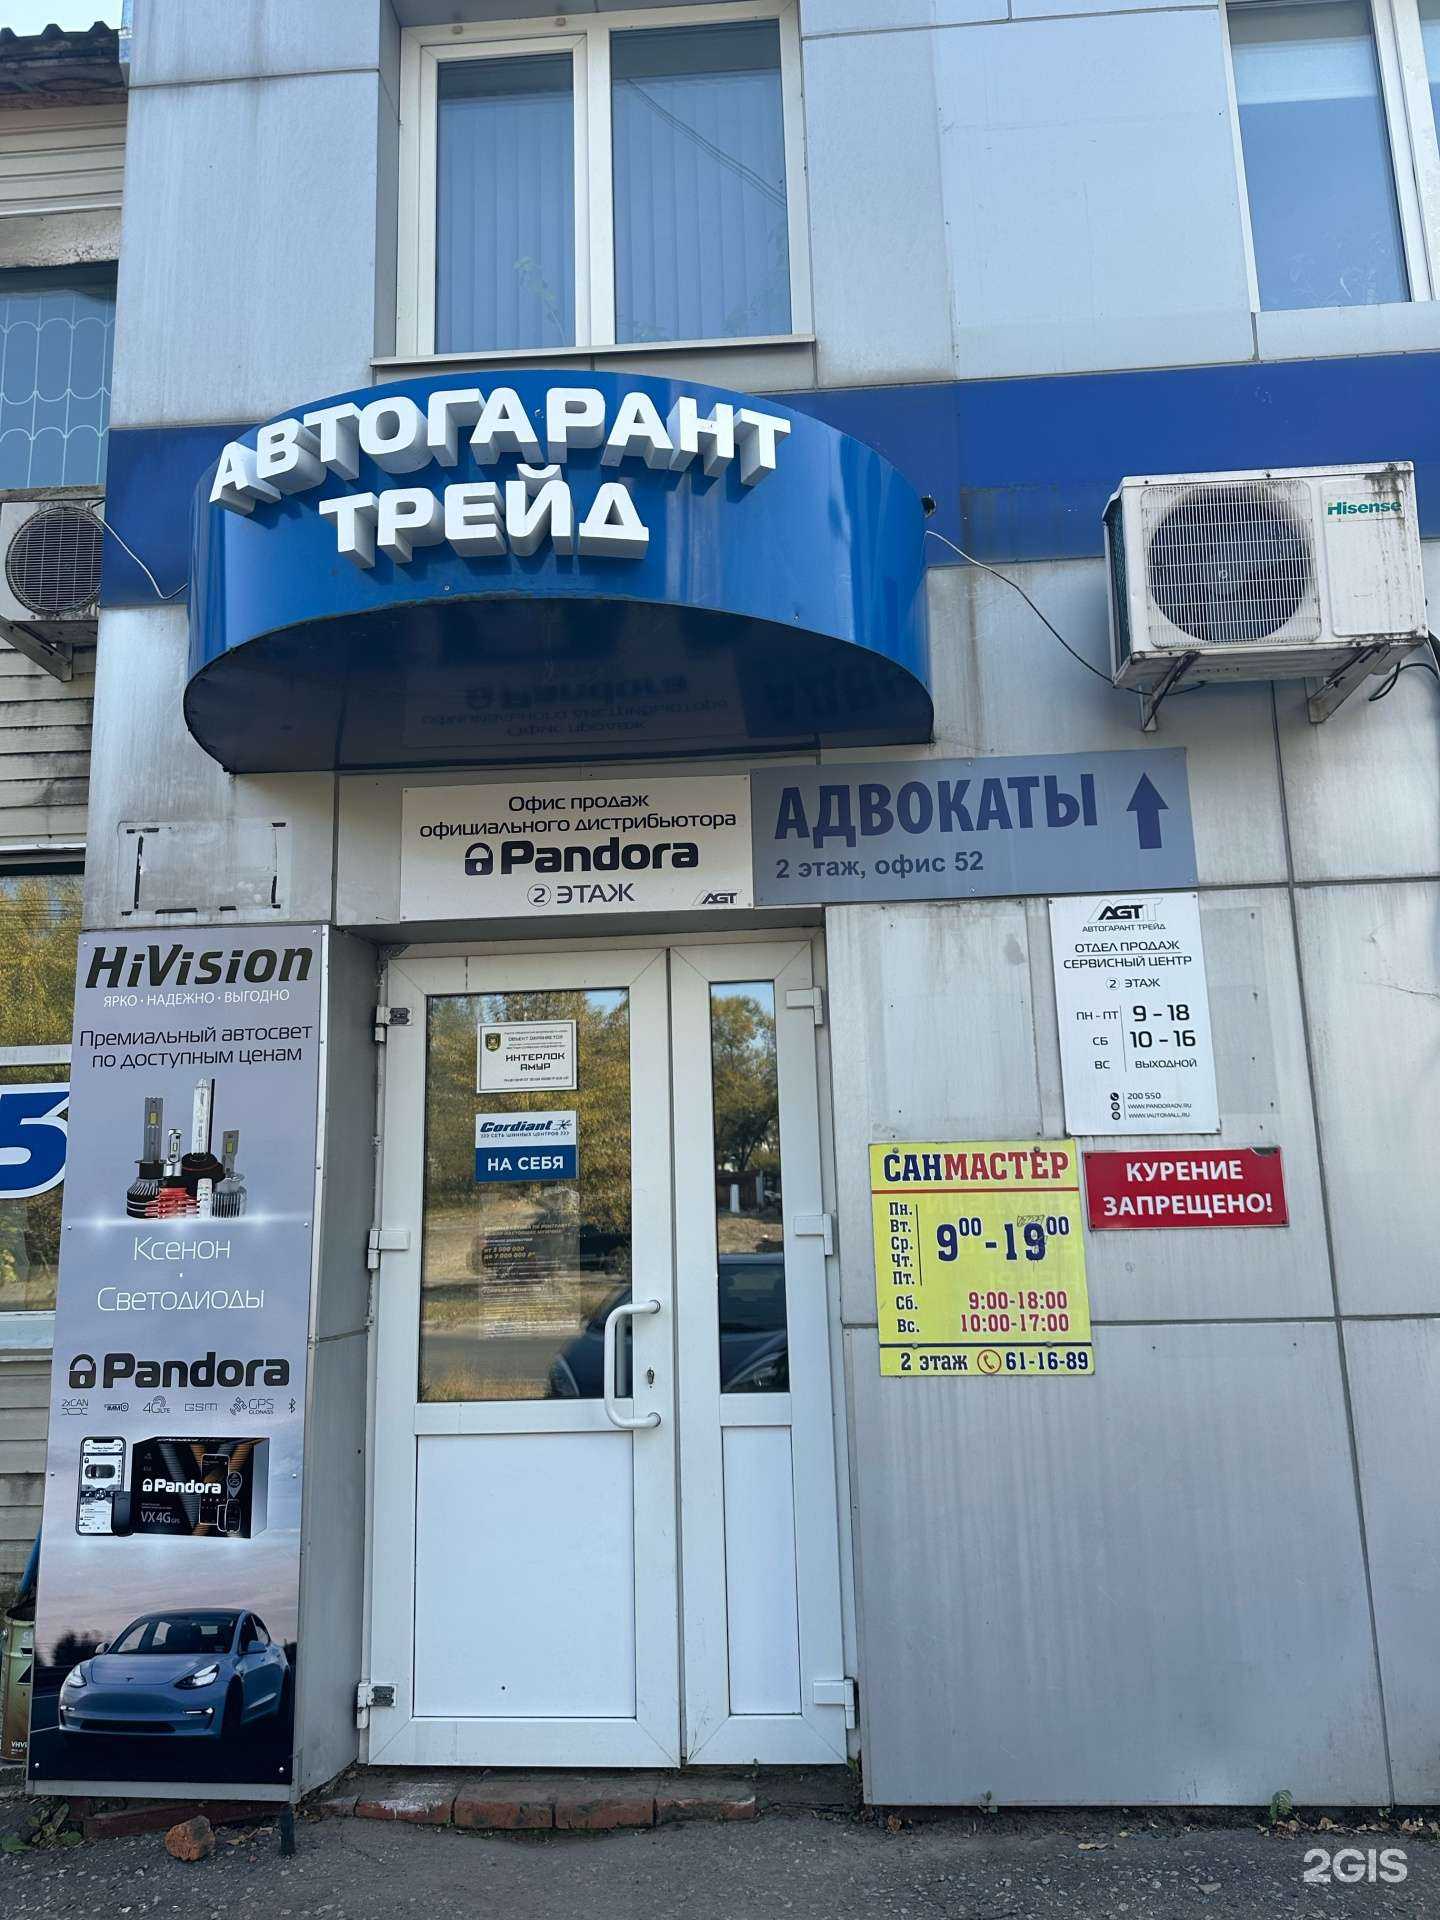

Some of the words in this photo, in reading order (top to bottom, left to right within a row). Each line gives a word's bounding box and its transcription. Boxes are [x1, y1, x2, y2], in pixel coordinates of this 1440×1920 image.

[209, 387, 792, 512] АВТОГАРАНТ
[319, 463, 649, 567] ТРЕЙД
[1327, 499, 1402, 516] Hisense
[508, 795, 567, 815] Офис
[570, 793, 650, 813] продаж
[774, 773, 1099, 849] АДВОКАТЫ
[419, 817, 571, 840] официального
[574, 812, 737, 833] дистрибьютора
[500, 836, 699, 875] Pandora
[776, 859, 790, 879] 2
[797, 858, 866, 880] этаж,
[874, 854, 946, 879] офис
[954, 850, 984, 871] 52
[556, 882, 635, 904] ЭТАЖ
[701, 893, 738, 905] AGT
[1098, 904, 1144, 920] AGT
[1082, 924, 1136, 933] АВТОГАРАНТ
[1137, 922, 1166, 931] ТРЕЙД
[1074, 942, 1118, 953] ОТДЕЛ
[1120, 940, 1180, 951] ПРОДАЖ
[85, 944, 313, 988] HiVision
[1063, 956, 1146, 969] СЕРВИСНЫЙ
[1148, 956, 1192, 968] ЦЕНТР
[1125, 978, 1161, 988] ЭТАЖ
[103, 994, 138, 1008] ЯРКО
[147, 992, 215, 1007] НАДЕЖНО
[224, 989, 290, 1005] ВЫГОДНО
[80, 1026, 217, 1050] Премиальный
[222, 1025, 313, 1042] автосвет
[1092, 1036, 1109, 1046] СБ
[92, 1054, 117, 1068] по
[120, 1050, 235, 1070] доступным
[239, 1047, 303, 1065] ценам
[505, 1052, 566, 1062] ИНТЕРЛОК
[1094, 1060, 1110, 1070] ВС
[1135, 1058, 1197, 1069] ВЫХОДНОЙ
[1127, 1092, 1143, 1100] 200
[1144, 1091, 1161, 1100] 550
[480, 1120, 554, 1133] Cordiant
[487, 1158, 512, 1171] НА
[518, 1156, 564, 1170] СЕБЯ
[884, 1151, 1069, 1182] САНМАСТЕР
[1126, 1160, 1244, 1182] КУРЕНИЕ
[889, 1202, 913, 1216] Пн.
[1103, 1193, 1273, 1219] ЗАПРЕЩЕНО!
[890, 1219, 911, 1233] Вт.
[134, 1237, 231, 1261] Ксенон
[891, 1237, 913, 1253] Ср.
[892, 1254, 913, 1268] Чт.
[893, 1271, 915, 1285] Пт.
[97, 1287, 265, 1311] Светодиоды
[896, 1296, 918, 1310] Сб.
[968, 1291, 1068, 1310] 9:00-18:00
[897, 1319, 920, 1333] Вс.
[961, 1313, 1070, 1333] 10:00-17:00
[900, 1352, 912, 1371] 2
[919, 1355, 968, 1371] этаж
[1006, 1351, 1088, 1371] 61-16-89
[102, 1352, 290, 1389] Pandora
[249, 1398, 275, 1410] GPS
[154, 1478, 221, 1494] Pandora
